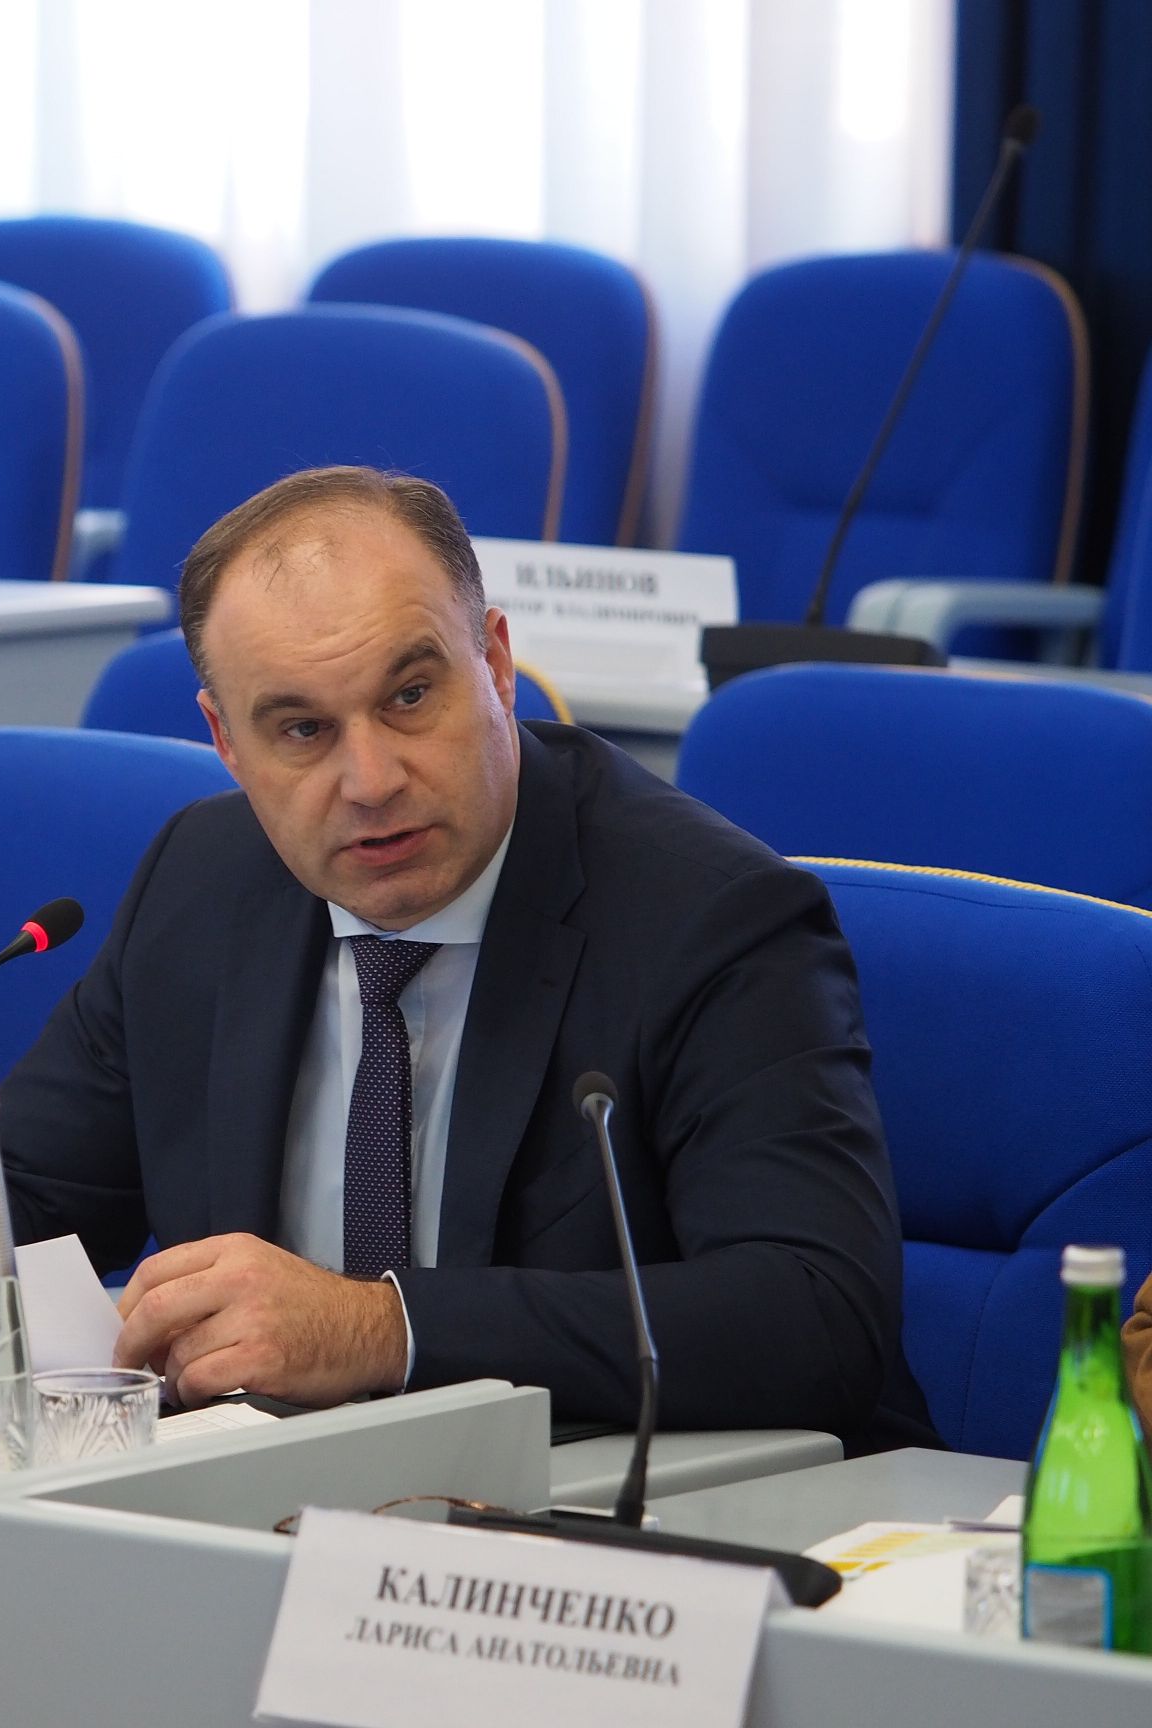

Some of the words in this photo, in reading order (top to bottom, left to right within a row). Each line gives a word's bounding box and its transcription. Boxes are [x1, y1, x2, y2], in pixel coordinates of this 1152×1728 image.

[376, 1566, 675, 1640] КАЛИНЧЕНКО
[345, 1617, 459, 1656] ЛАРИСА
[469, 1636, 680, 1687] АНАТОЛЬЕВНА
